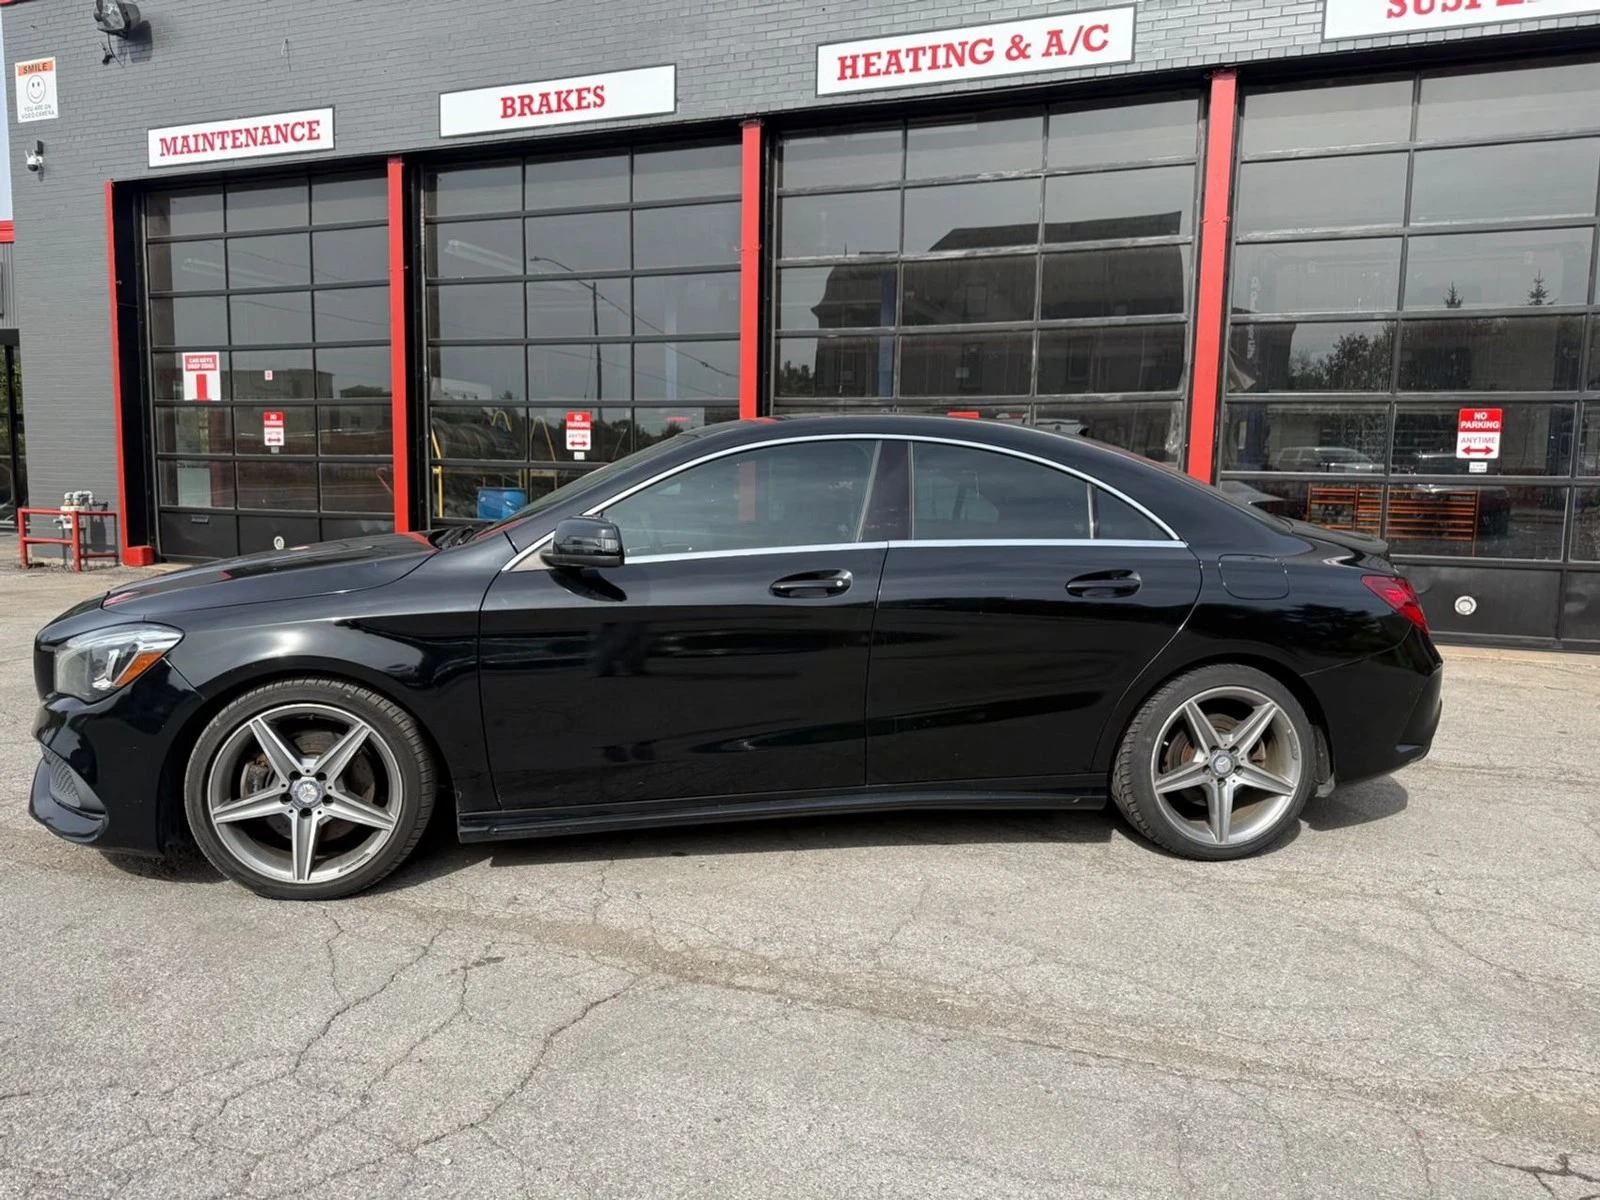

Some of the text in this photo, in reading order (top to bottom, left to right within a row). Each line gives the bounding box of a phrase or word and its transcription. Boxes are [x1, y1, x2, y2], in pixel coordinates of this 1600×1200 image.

[837, 23, 1109, 81] HEATING & A/C
[23, 62, 48, 74] SMILE
[500, 85, 606, 119] BRAKES
[159, 120, 321, 158] MAINTENANCE
[1460, 420, 1499, 429] PARKING
[1474, 412, 1487, 420] NO
